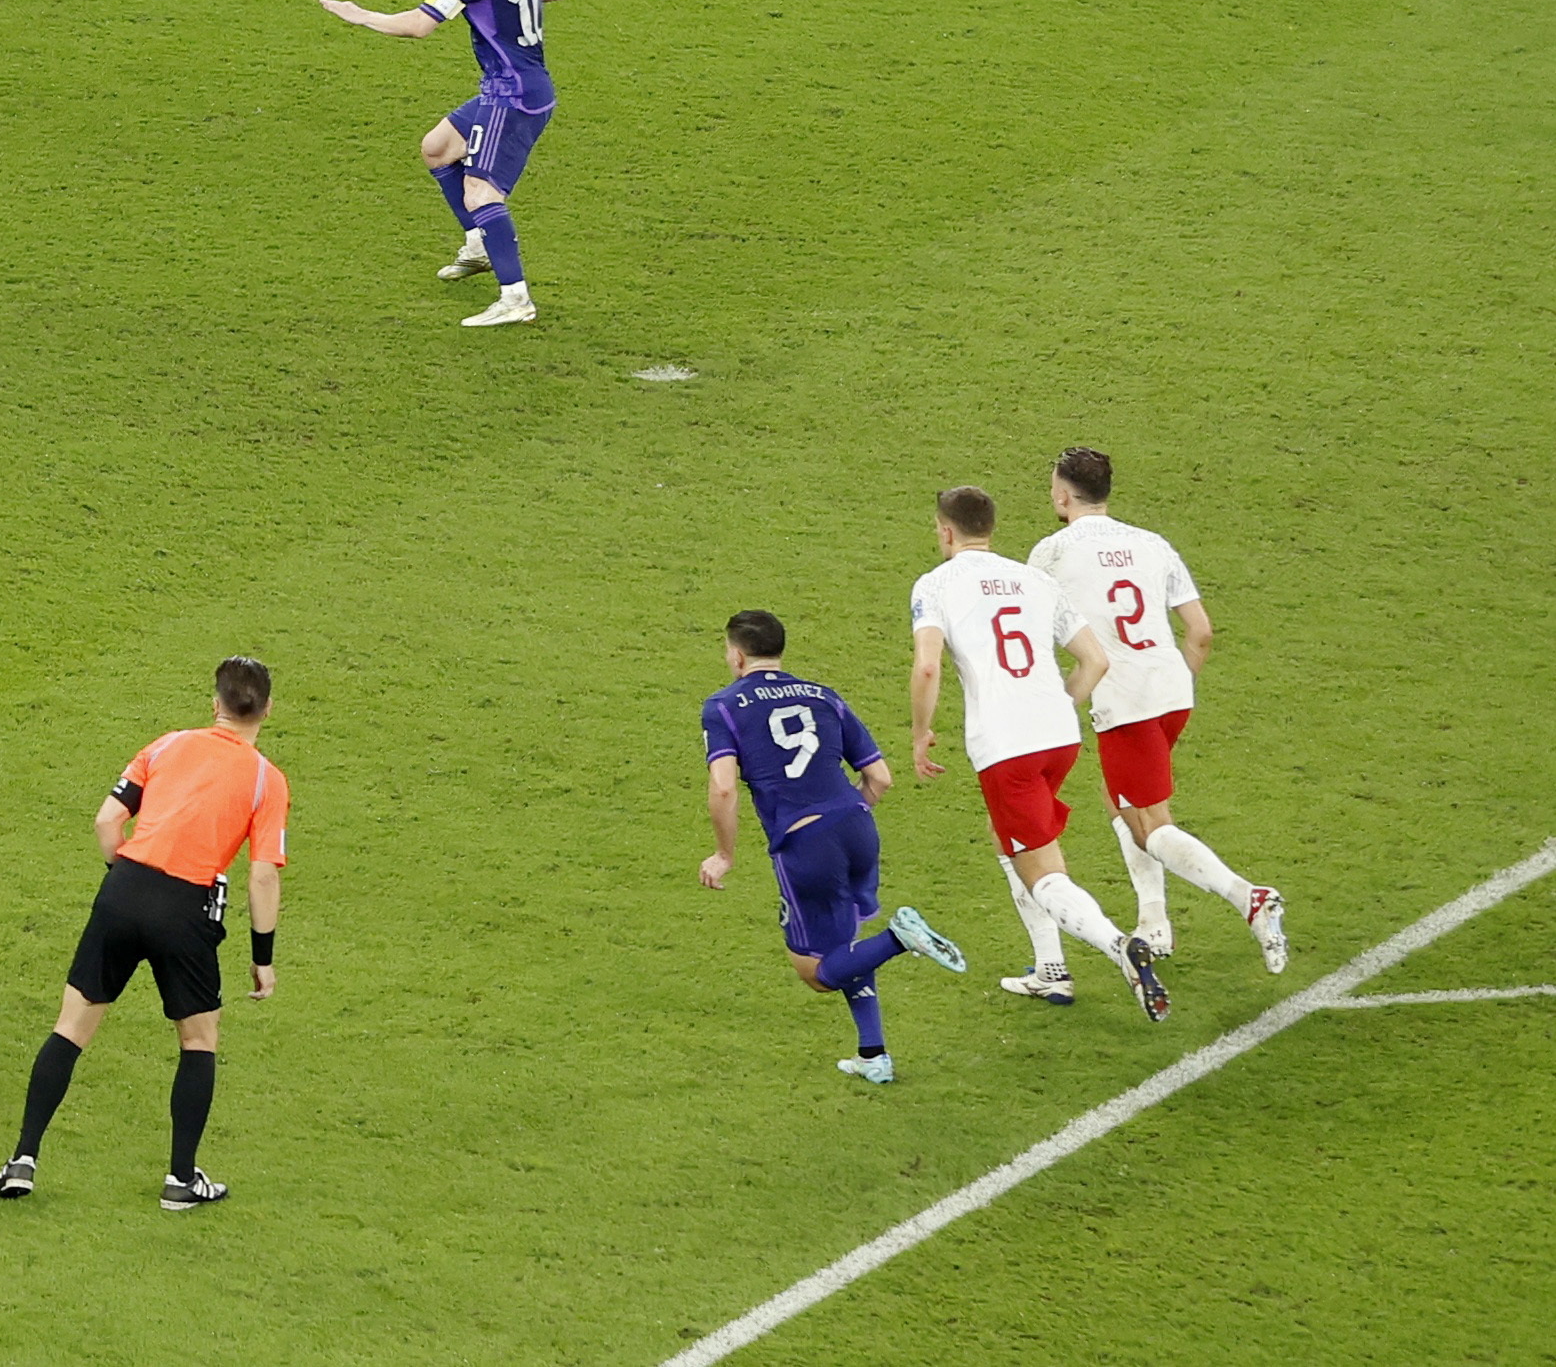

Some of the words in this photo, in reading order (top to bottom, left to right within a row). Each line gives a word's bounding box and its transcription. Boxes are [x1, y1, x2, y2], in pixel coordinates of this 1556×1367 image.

[1096, 549, 1135, 568] CASH
[979, 579, 1025, 597] BIELIK
[1106, 579, 1157, 651] 2
[990, 605, 1036, 679] 6
[736, 693, 754, 708] J.
[755, 683, 827, 702] ALVAREZ
[767, 704, 820, 779] 9
